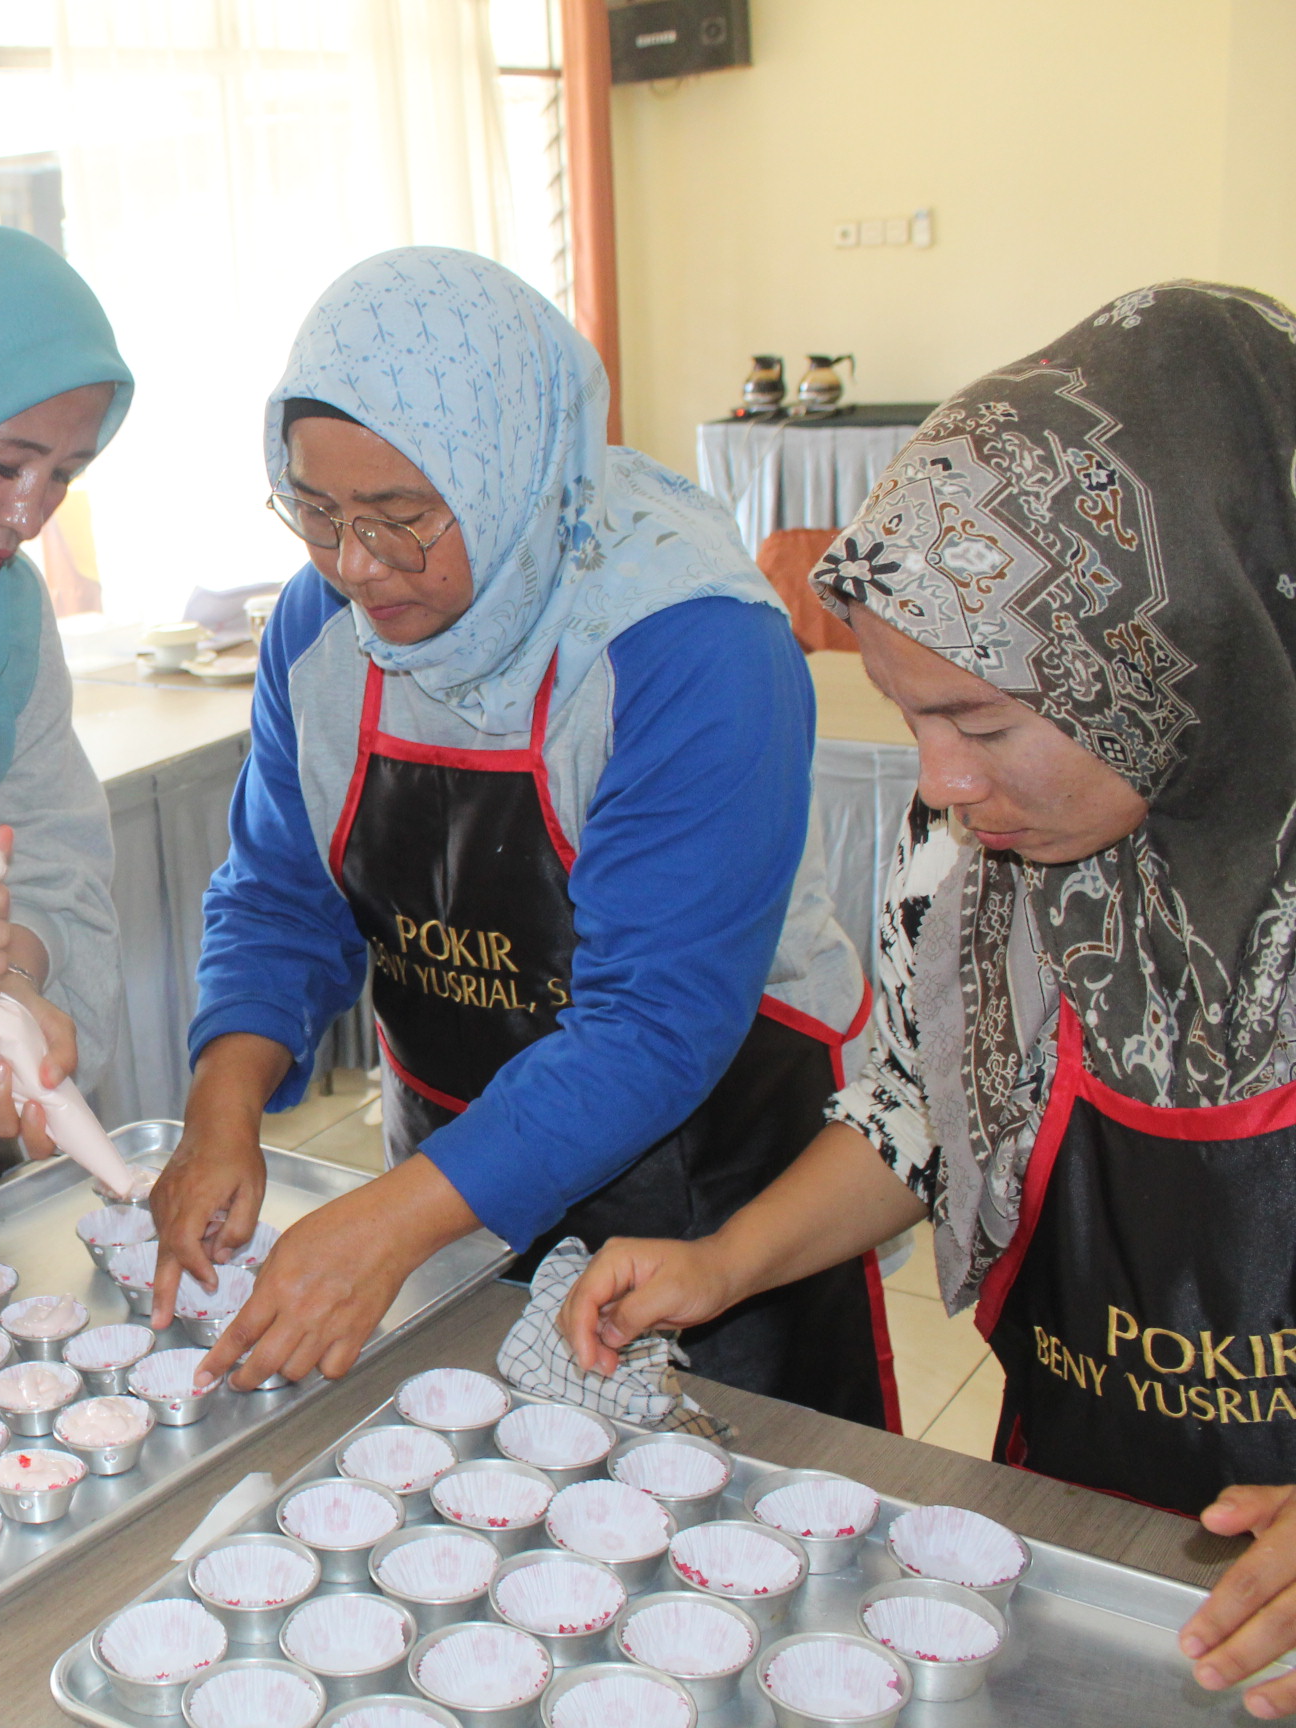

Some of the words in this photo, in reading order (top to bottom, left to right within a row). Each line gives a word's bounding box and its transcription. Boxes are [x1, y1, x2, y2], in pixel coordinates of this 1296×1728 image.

[395, 914, 520, 973] POKIR
[413, 963, 537, 1013] YUSRIAL,
[1033, 1325, 1108, 1397] BENY
[1107, 1304, 1296, 1380] POKIR
